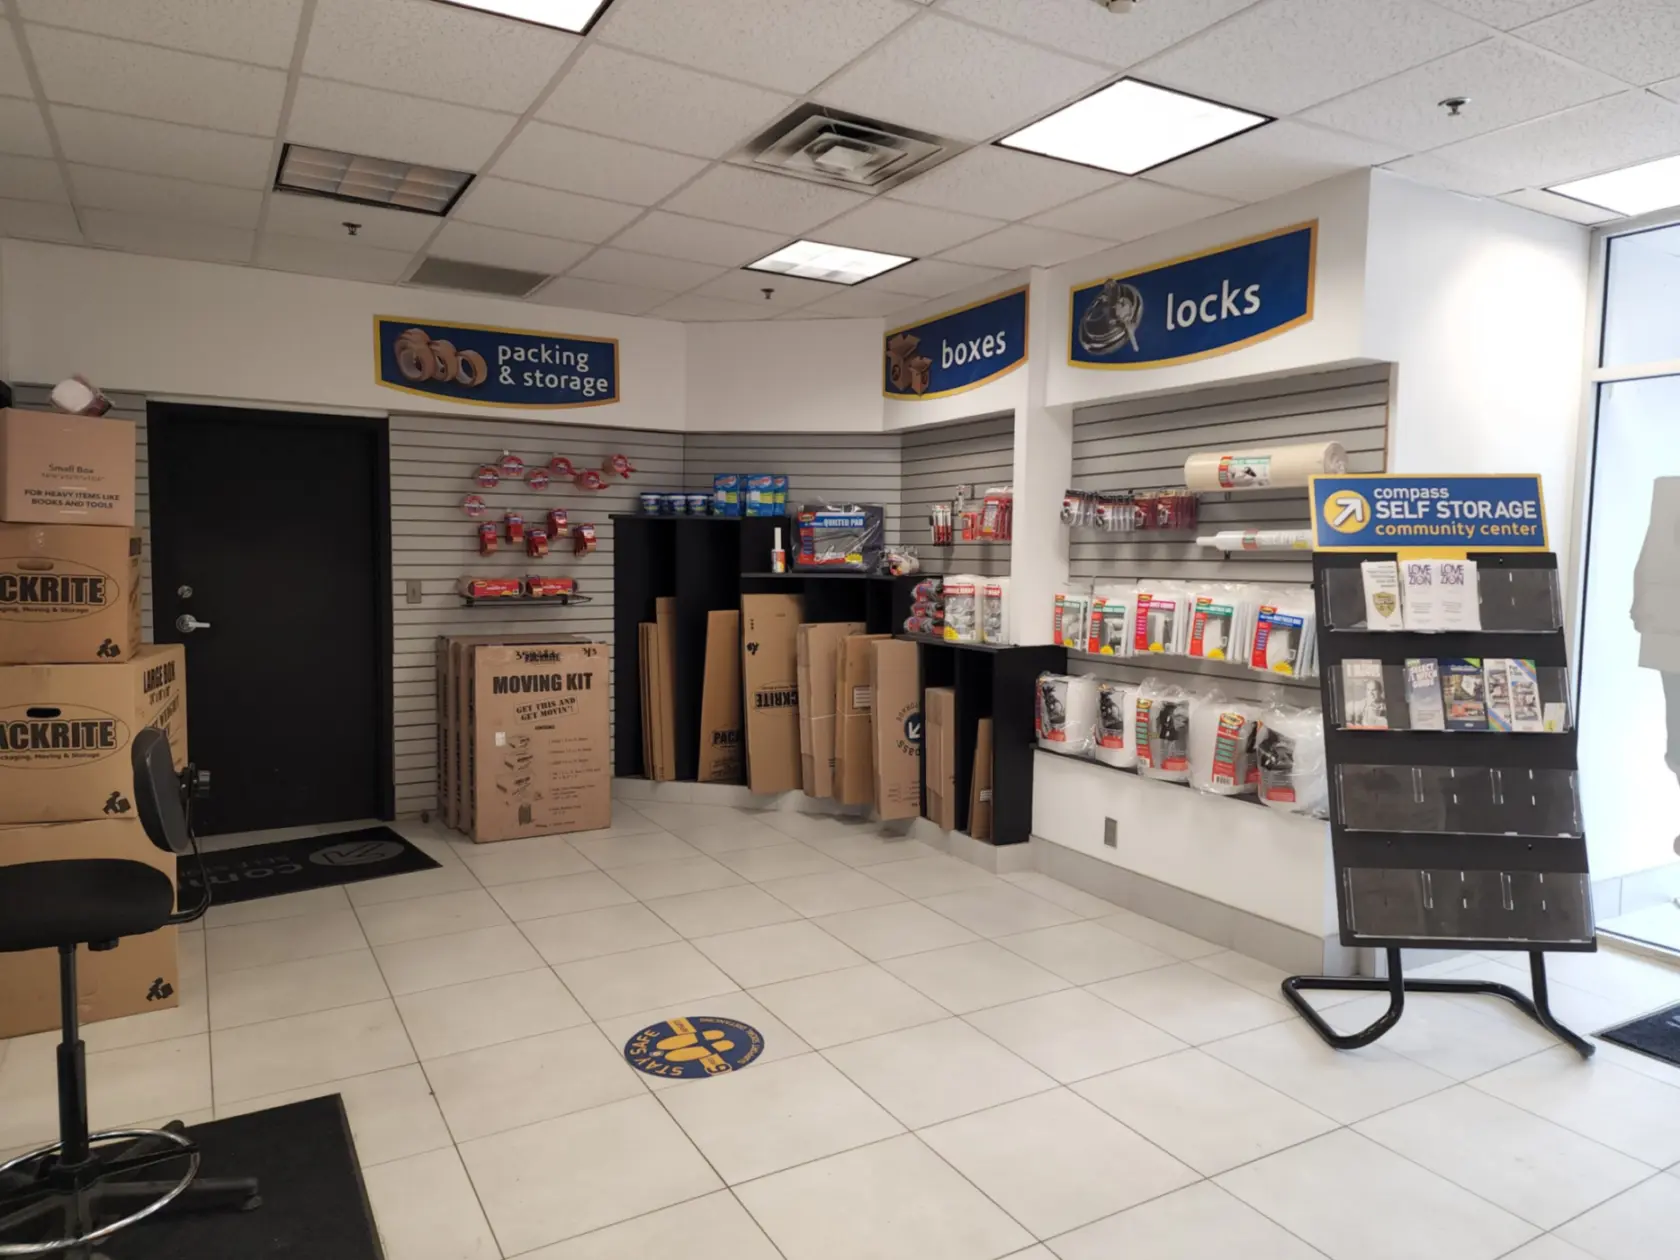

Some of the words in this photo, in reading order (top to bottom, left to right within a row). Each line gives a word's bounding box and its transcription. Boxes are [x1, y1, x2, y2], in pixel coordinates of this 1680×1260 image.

[1165, 280, 1262, 331] locks
[941, 329, 1007, 369] boxes
[497, 343, 589, 373] packing
[499, 366, 515, 385] &
[523, 371, 609, 397] storage
[49, 463, 75, 473] Small
[76, 466, 94, 474] Box
[1373, 487, 1449, 501] compass
[31, 498, 62, 506] BOOKS
[64, 500, 84, 508] AND
[1376, 501, 1430, 519] SELF
[1436, 501, 1537, 519] STORAGE
[1375, 521, 1475, 538] community
[1480, 524, 1537, 536] center
[1408, 564, 1432, 575] LOVE
[1440, 564, 1465, 574] LOVE
[1408, 574, 1432, 586] ZION
[1440, 574, 1464, 586] ZION
[493, 674, 562, 694] MOVING
[566, 672, 593, 691] KIT
[516, 704, 534, 714] GET
[536, 701, 557, 712] THIS
[559, 697, 576, 706] AND
[521, 712, 538, 721] GET
[630, 1029, 661, 1056] SAFE
[635, 1056, 684, 1077] STAY
